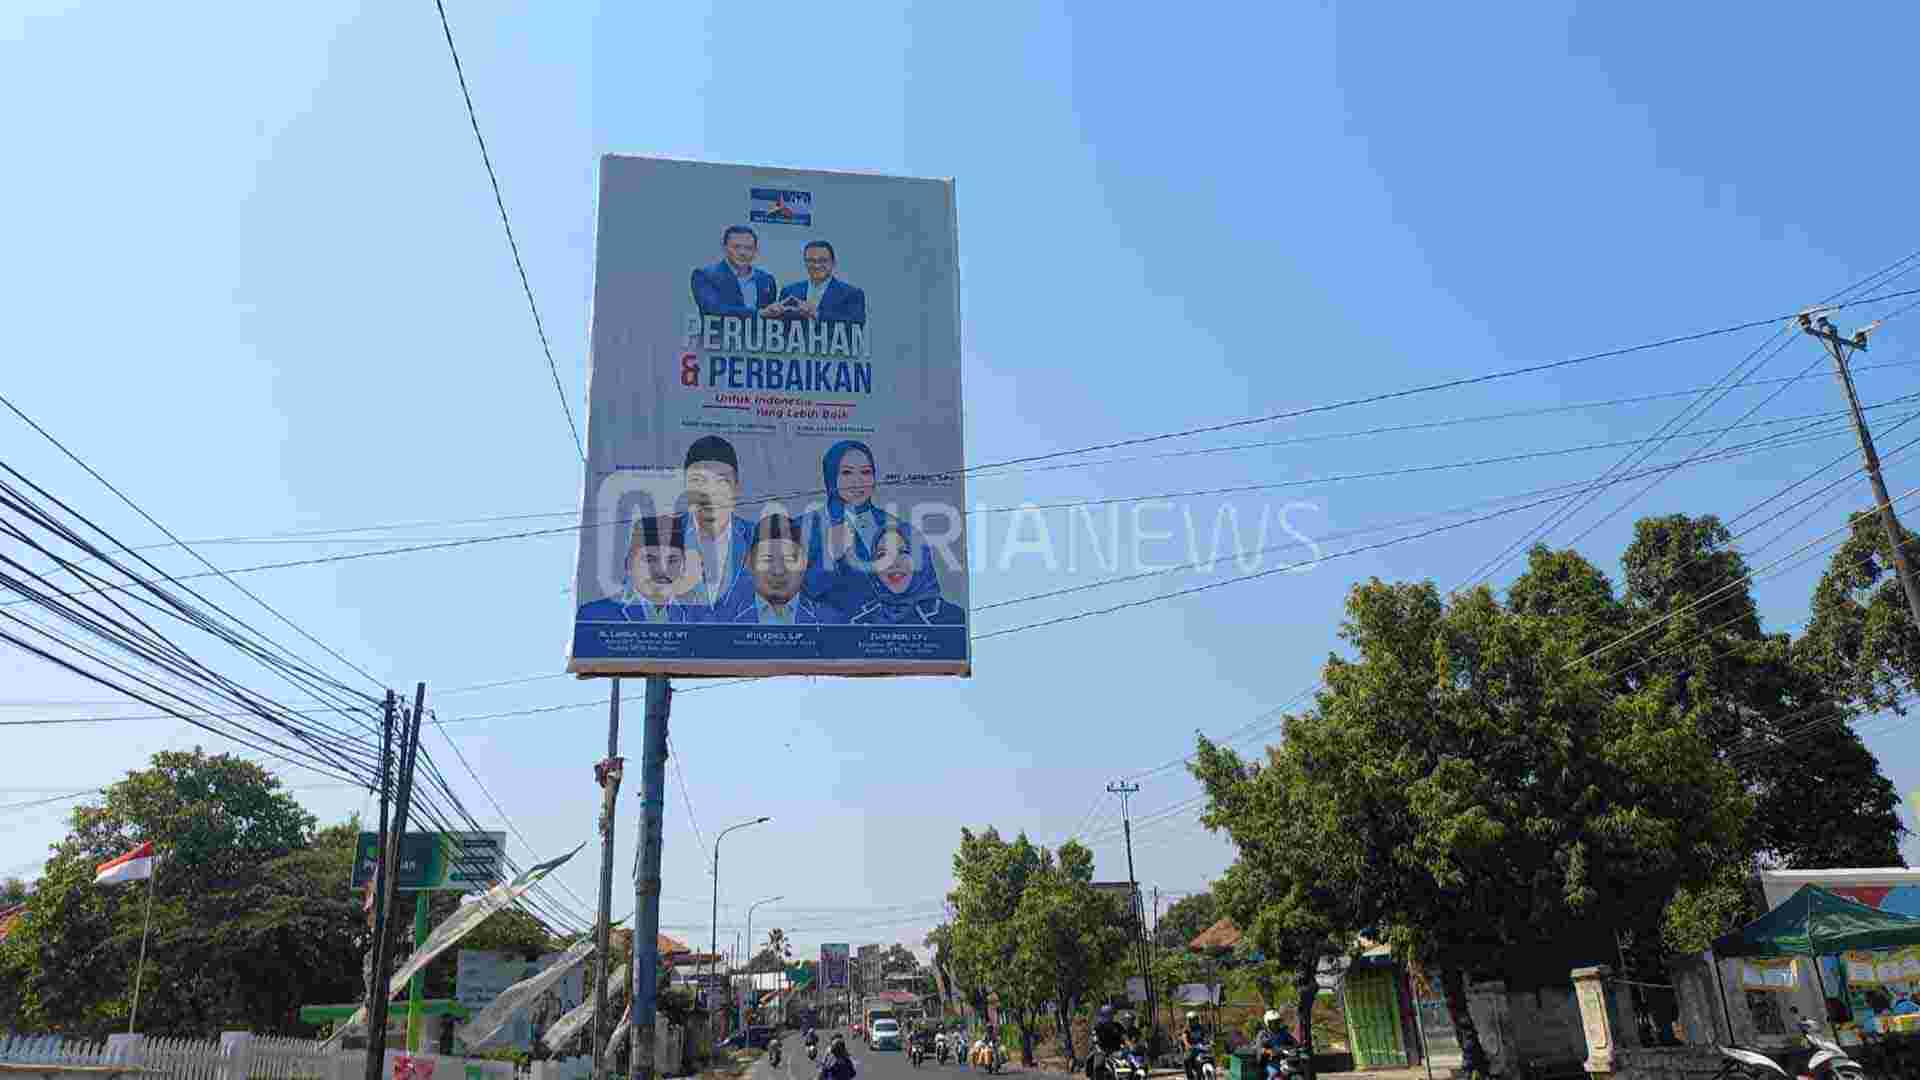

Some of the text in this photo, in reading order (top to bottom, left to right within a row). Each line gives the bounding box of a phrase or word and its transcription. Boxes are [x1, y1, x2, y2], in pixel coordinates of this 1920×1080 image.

[684, 314, 871, 356] PERUBAHAN
[681, 352, 872, 393] & PERBAIKAN
